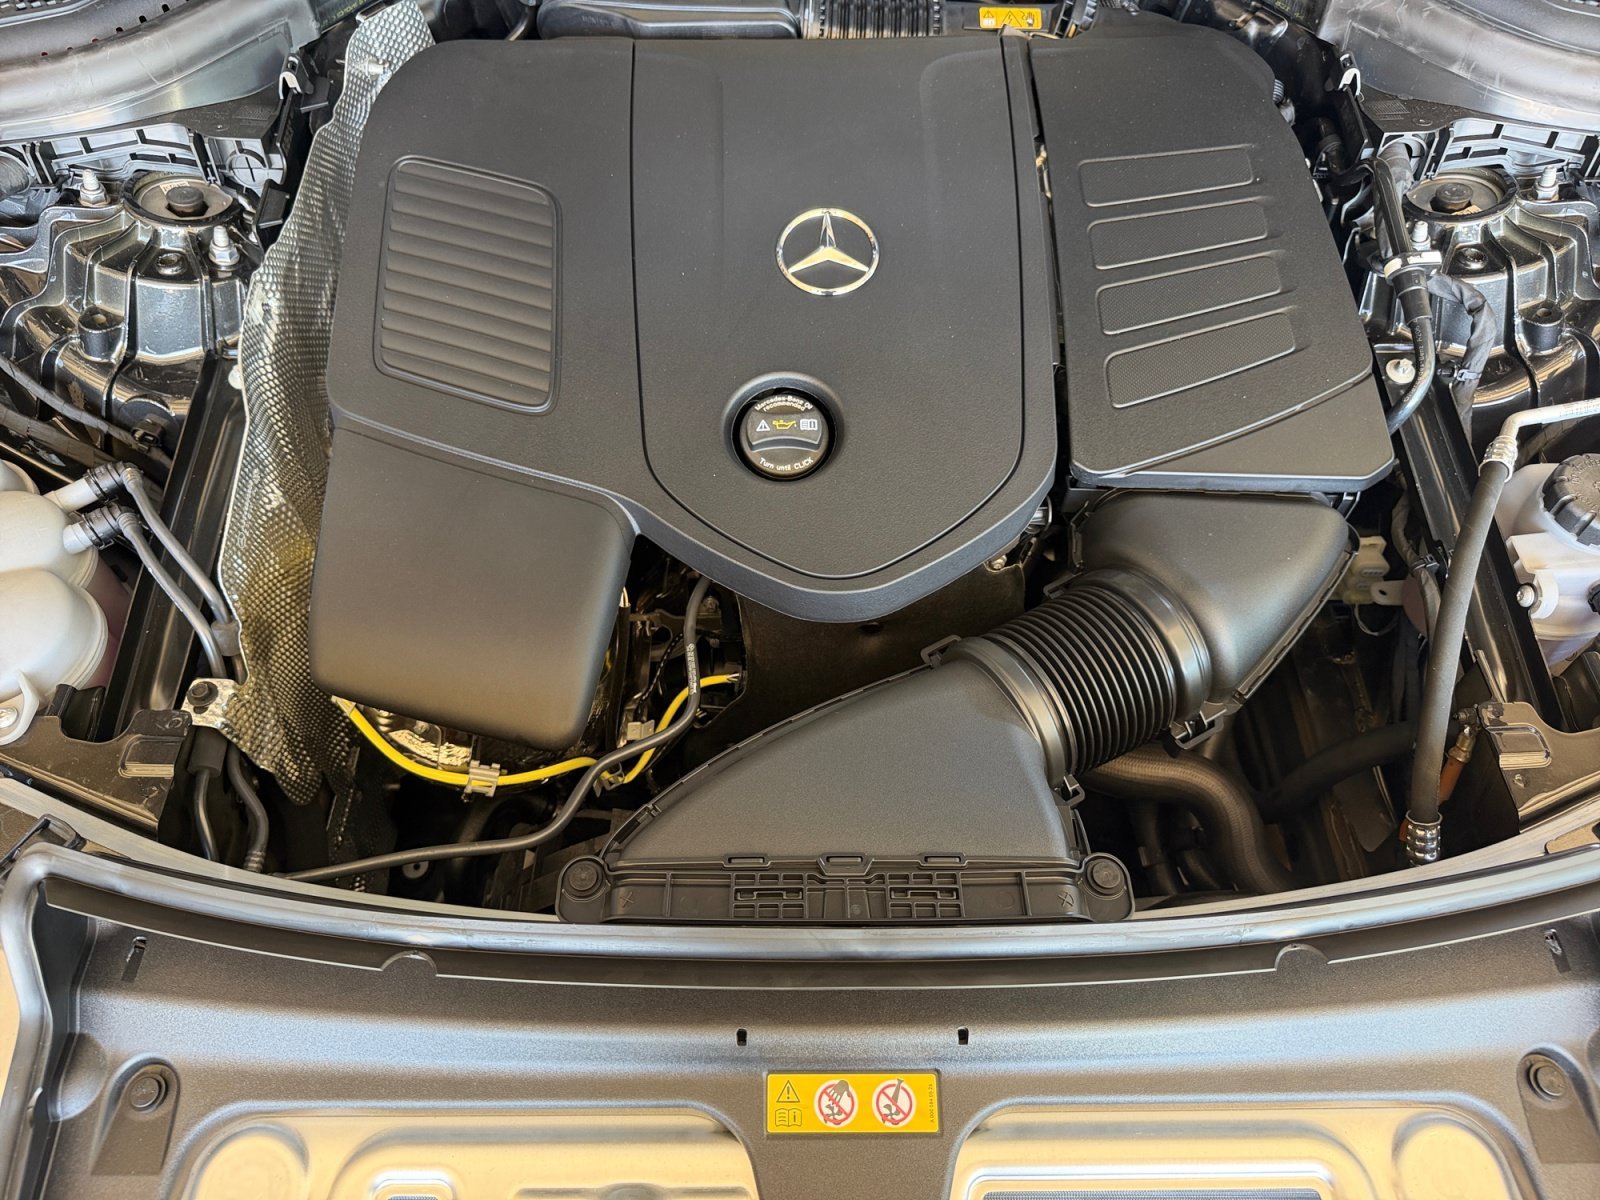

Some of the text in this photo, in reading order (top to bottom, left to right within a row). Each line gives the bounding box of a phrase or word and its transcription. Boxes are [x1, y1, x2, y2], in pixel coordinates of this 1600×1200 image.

[754, 395, 813, 411] Mercedes-Benz Oil
[763, 402, 805, 411] recommended
[760, 457, 774, 469] Turn
[794, 456, 814, 470] CLICK
